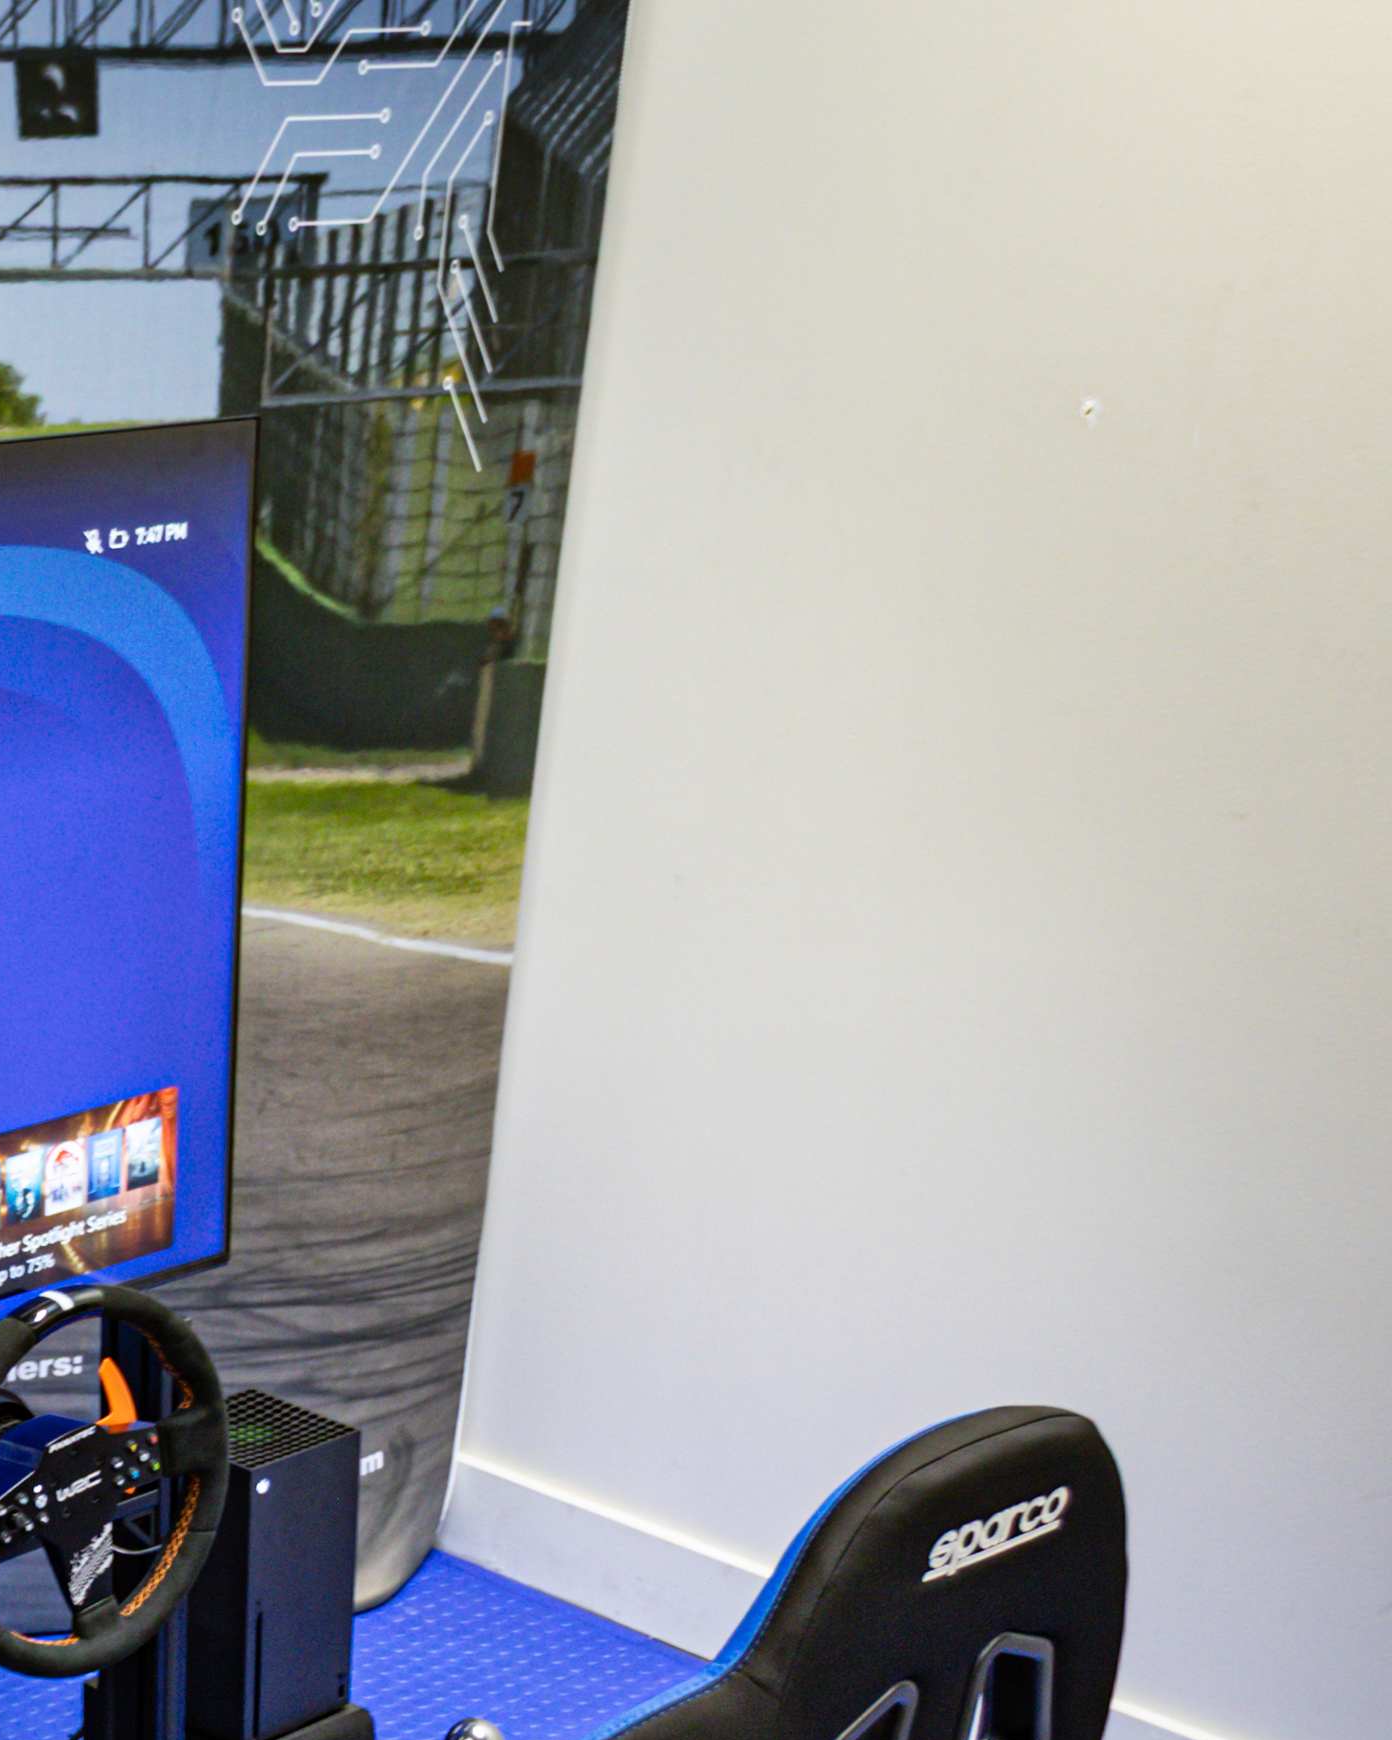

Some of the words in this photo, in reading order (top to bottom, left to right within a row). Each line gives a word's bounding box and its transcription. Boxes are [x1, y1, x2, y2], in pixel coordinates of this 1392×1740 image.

[164, 521, 188, 542] PM
[21, 1219, 86, 1254] Spotlight
[85, 1209, 127, 1233] Series
[9, 1263, 26, 1279] to
[25, 1252, 56, 1274] 75%
[921, 1485, 1073, 1583] sparco
